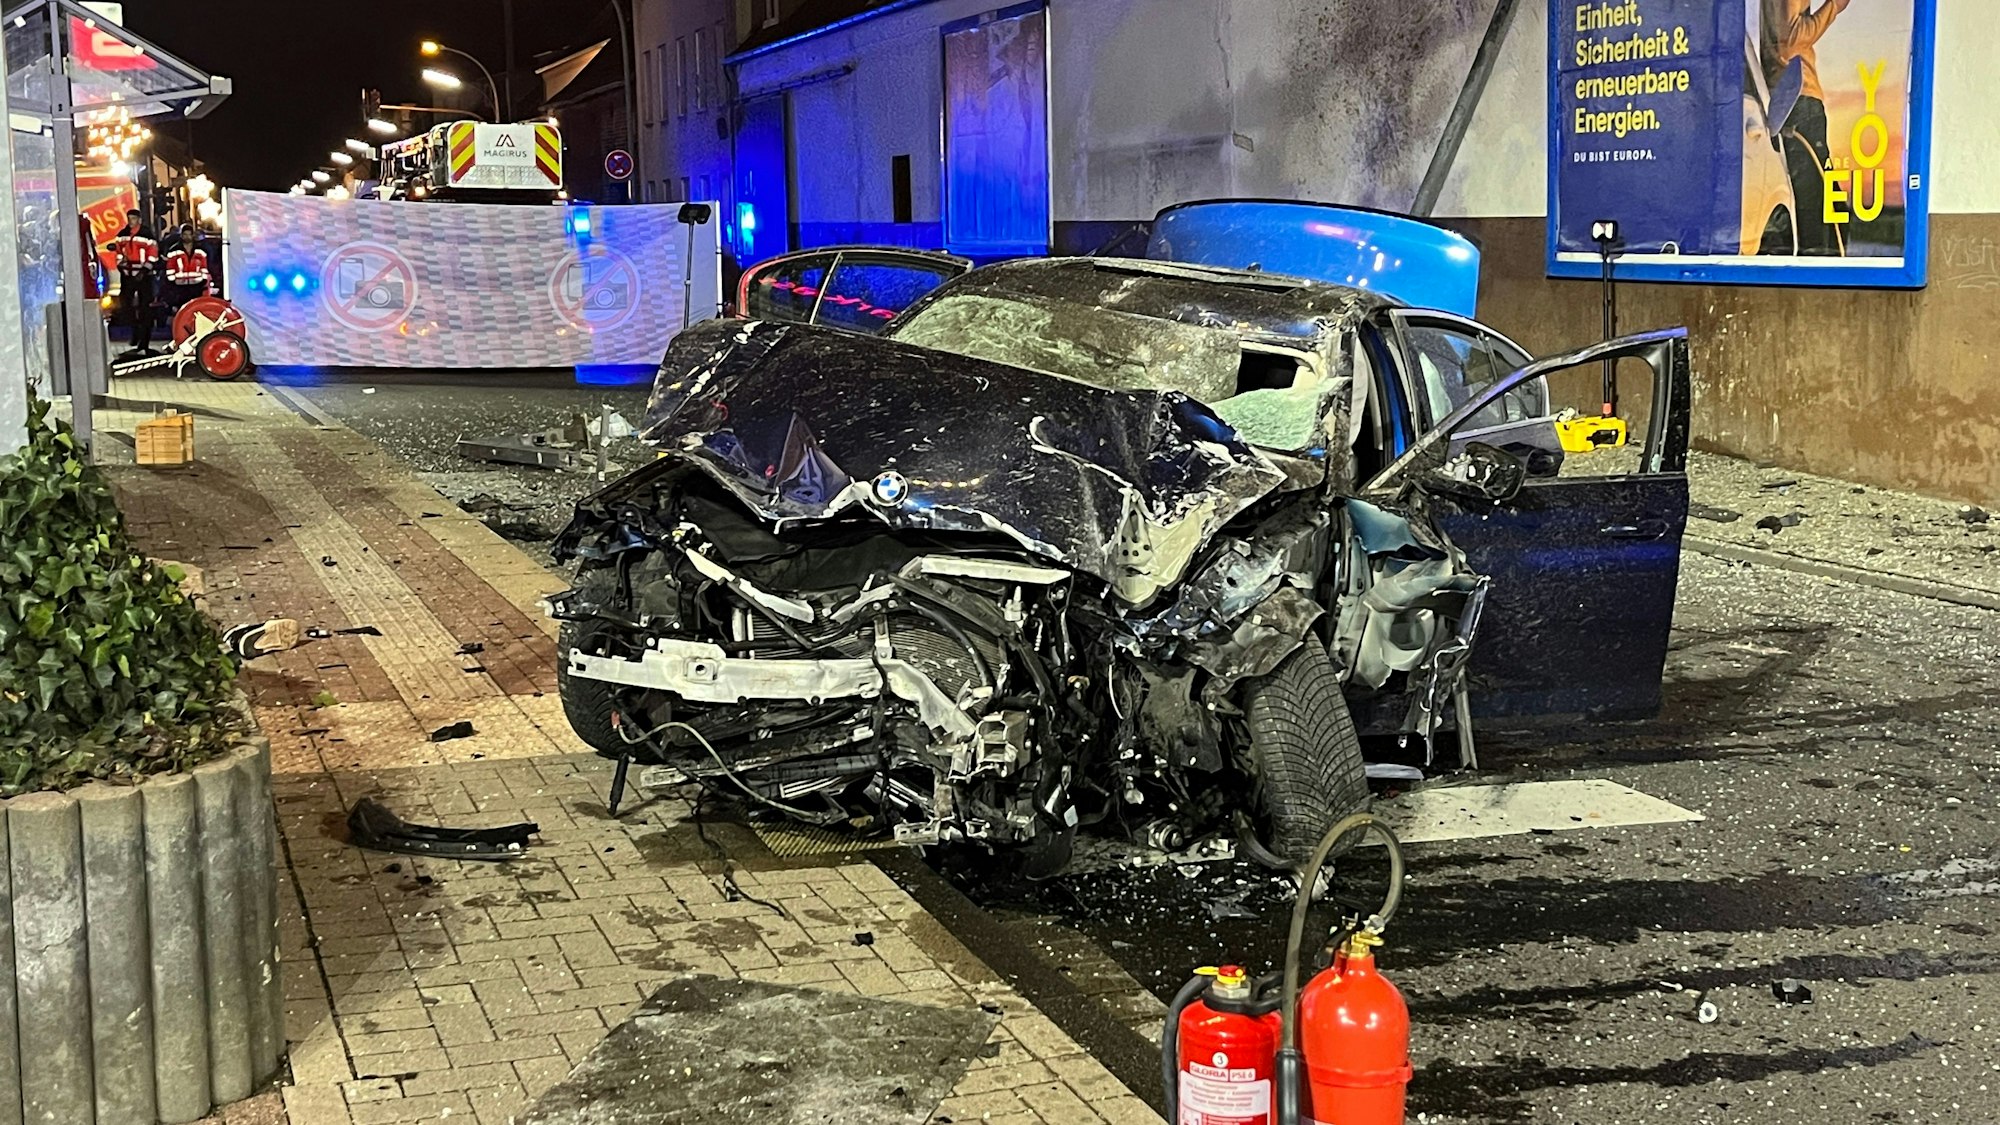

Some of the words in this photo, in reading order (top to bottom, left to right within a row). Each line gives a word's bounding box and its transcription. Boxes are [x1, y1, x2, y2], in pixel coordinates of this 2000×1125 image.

[1576, 0, 1642, 31] Einheit,
[1576, 28, 1669, 66] Sicherheit
[1673, 26, 1689, 55] &
[1575, 67, 1689, 99] erneuerbare
[1575, 102, 1660, 138] Energien.
[484, 149, 527, 158] MAGIRUS
[1574, 152, 1586, 162] DU
[1589, 151, 1611, 162] BIST
[1613, 149, 1657, 161] EUROPA.
[1824, 157, 1849, 170] ARE
[1823, 168, 1884, 224] EU
[89, 201, 129, 236] NST
[1191, 1065, 1226, 1078] GLORIA
[1217, 1055, 1224, 1065] 3
